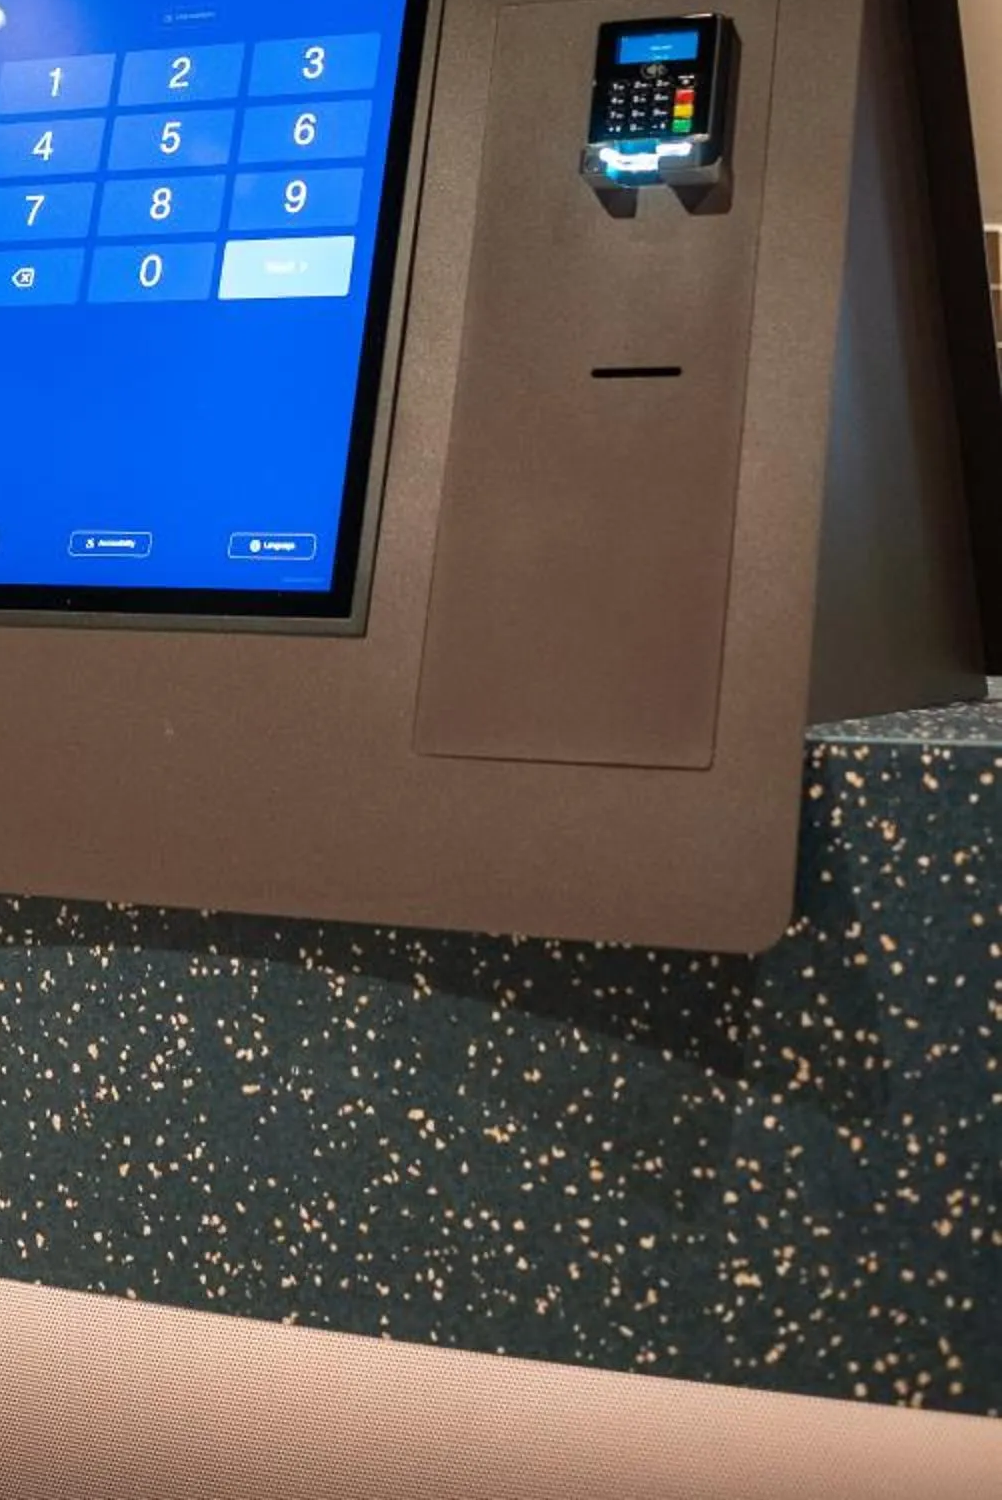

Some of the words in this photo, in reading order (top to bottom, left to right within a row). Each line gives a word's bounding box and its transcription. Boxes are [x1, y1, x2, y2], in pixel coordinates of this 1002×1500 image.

[49, 67, 62, 97] 1
[168, 56, 191, 89] 2
[302, 45, 325, 79] 3
[32, 130, 54, 161] 4
[159, 121, 182, 154] 5
[293, 112, 317, 146] 6
[25, 194, 46, 226] 7
[149, 187, 172, 220] 8
[284, 179, 308, 214] 9
[139, 253, 163, 288] 0
